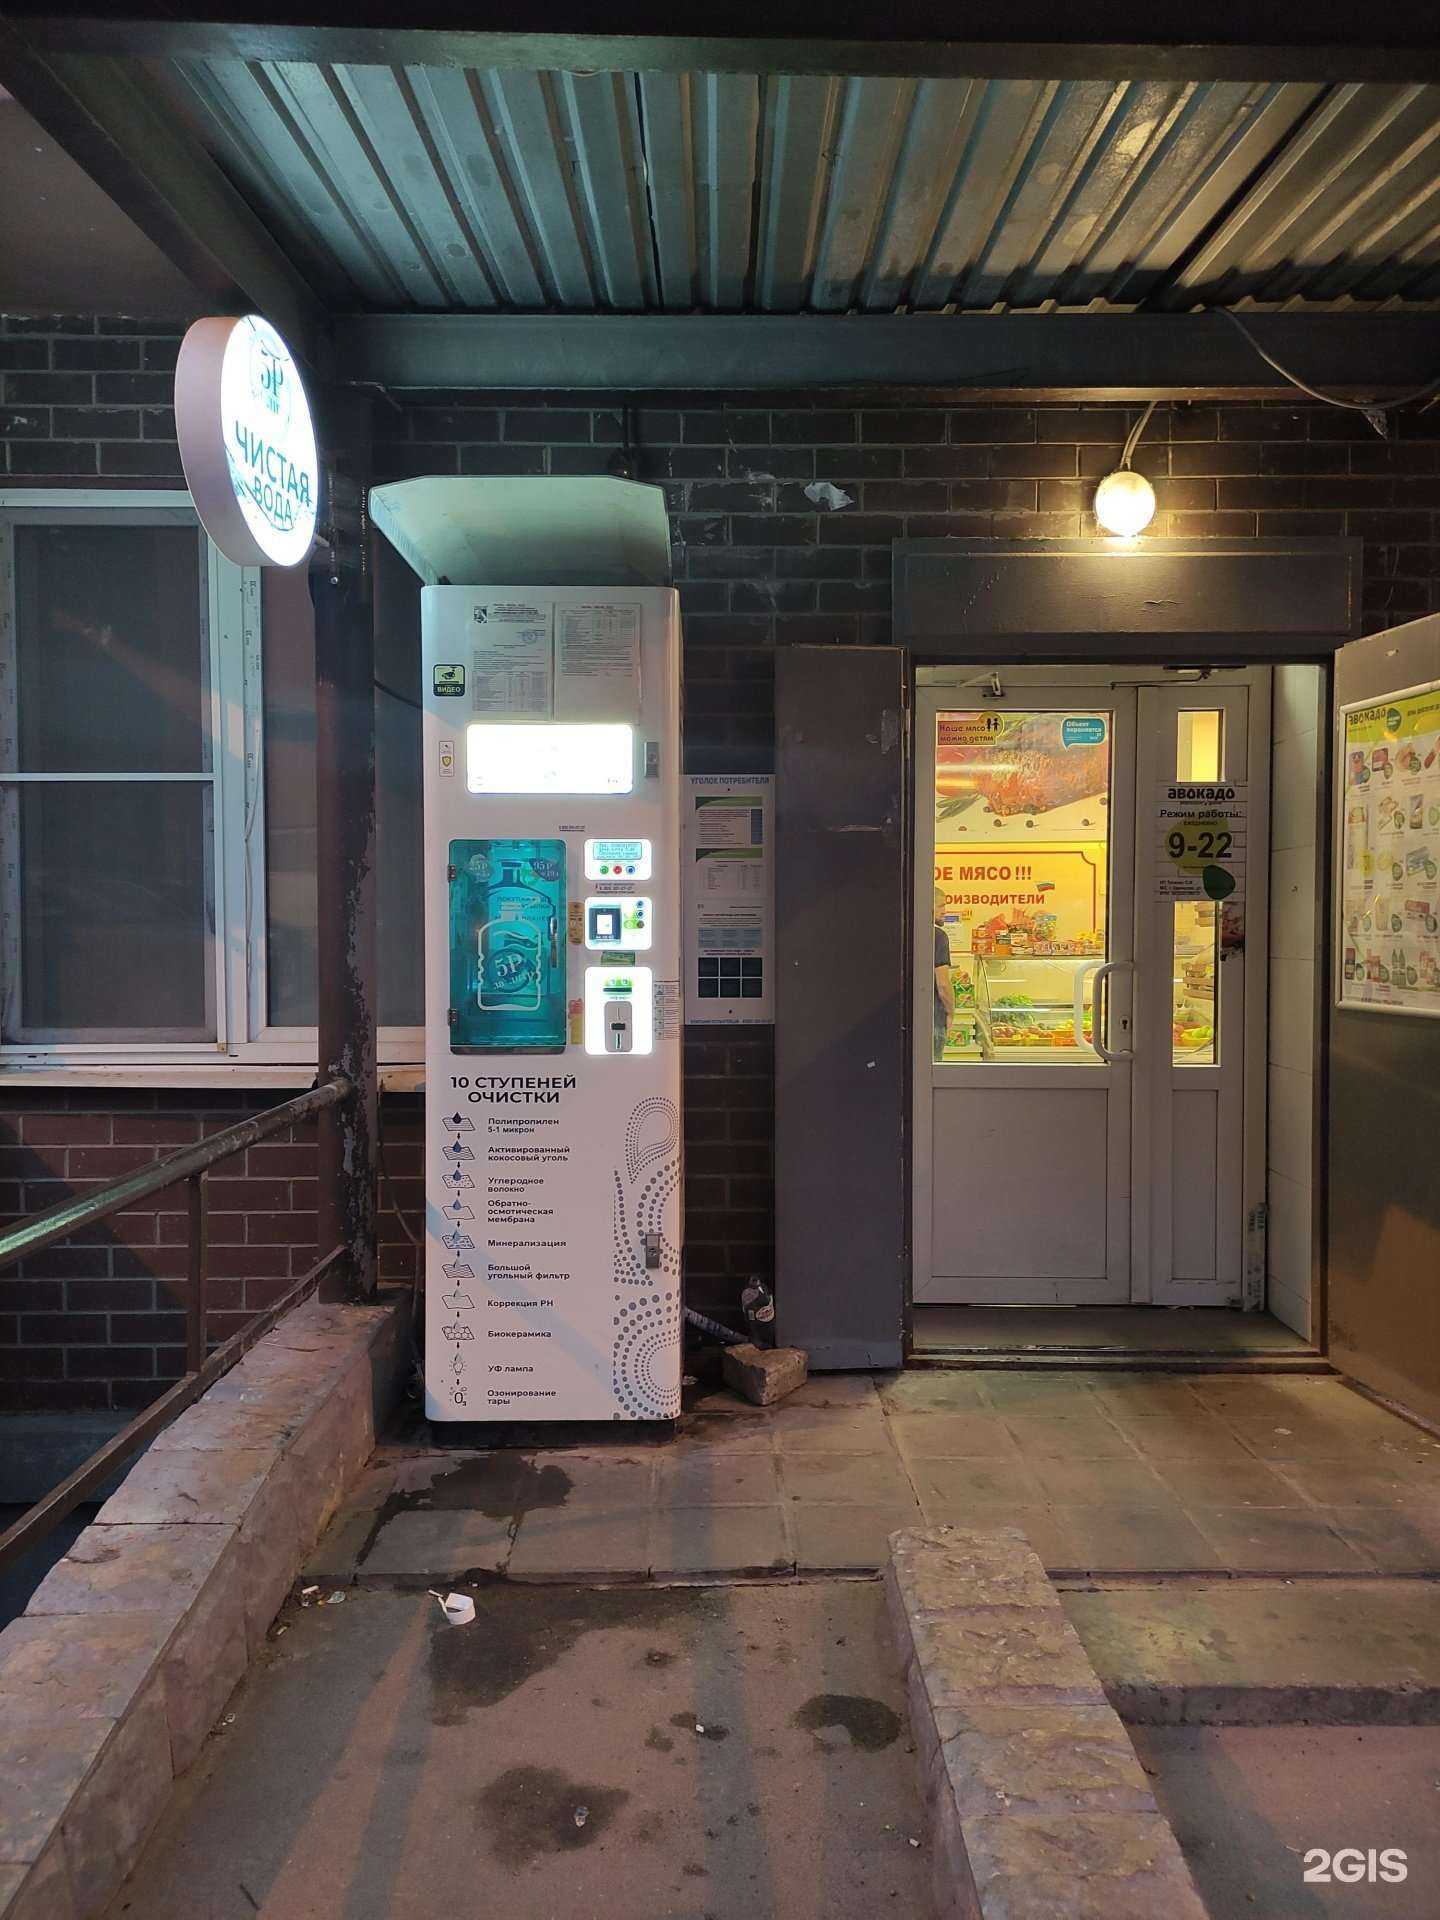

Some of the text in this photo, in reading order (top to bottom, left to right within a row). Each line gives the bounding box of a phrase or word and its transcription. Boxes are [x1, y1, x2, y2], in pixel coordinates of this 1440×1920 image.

[235, 420, 312, 507] ЧИСТАЯ
[254, 476, 293, 529] ВОДА
[437, 686, 461, 694] ВИДЕО
[1348, 707, 1386, 725] авокадо
[1168, 787, 1235, 801] авокадо
[1160, 808, 1242, 819] Режим работы:
[1168, 831, 1233, 858] 9-22
[450, 1074, 576, 1089] 10 СТУПЕНЕЙ
[468, 1091, 560, 1104] ОЧИСТКИ
[488, 1118, 559, 1127] Полипропилен
[502, 1127, 535, 1135] микрон
[542, 1155, 569, 1163] уголь
[488, 1177, 544, 1186] Углеродное
[488, 1200, 531, 1208] Обратно-
[488, 1216, 535, 1224] мембрана
[488, 1240, 567, 1248] Минерализация
[488, 1272, 570, 1280] угольный фильтр
[488, 1300, 538, 1308] Коррекция
[488, 1330, 552, 1338] Биокерамика
[488, 1365, 503, 1373] УФ
[488, 1390, 557, 1398] Озонирование
